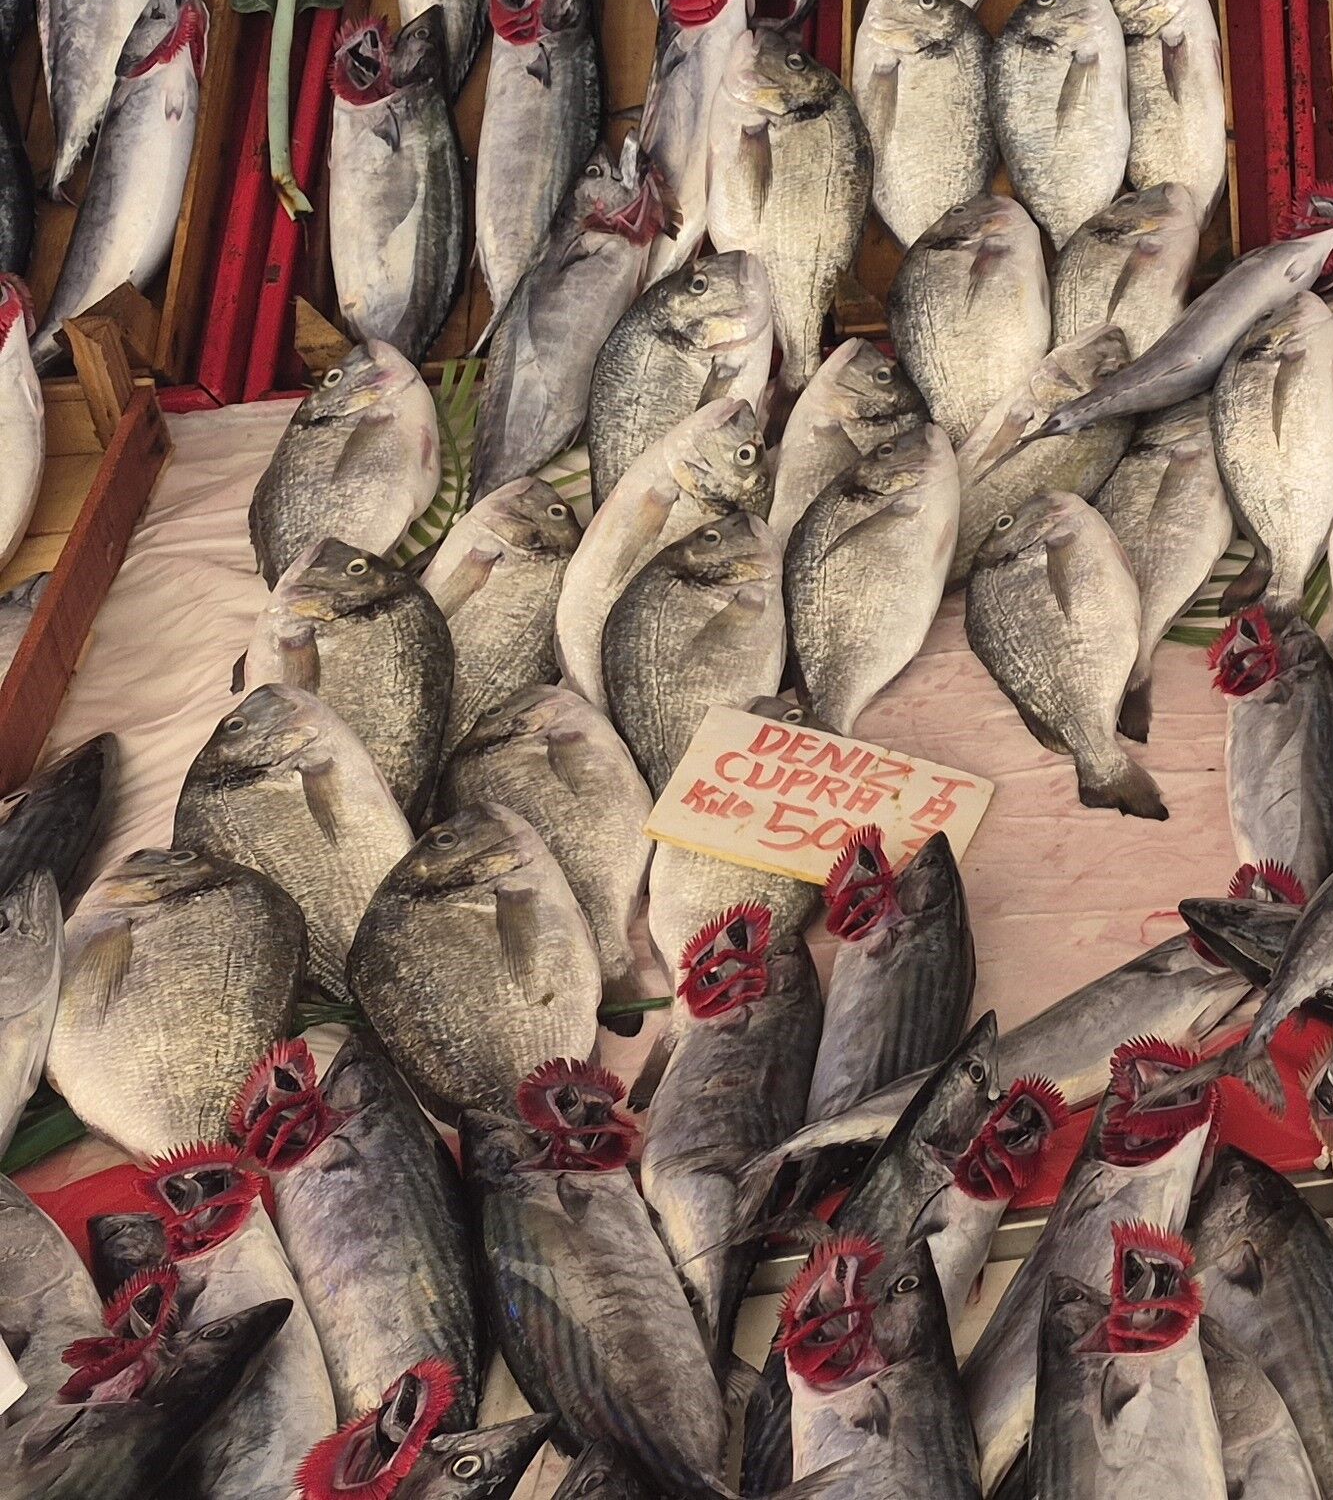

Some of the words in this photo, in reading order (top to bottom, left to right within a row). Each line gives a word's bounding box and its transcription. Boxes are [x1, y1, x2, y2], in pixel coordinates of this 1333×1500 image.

[713, 751, 884, 815] CUPRA
[747, 722, 917, 796] DENIZ
[756, 800, 887, 852] 50
